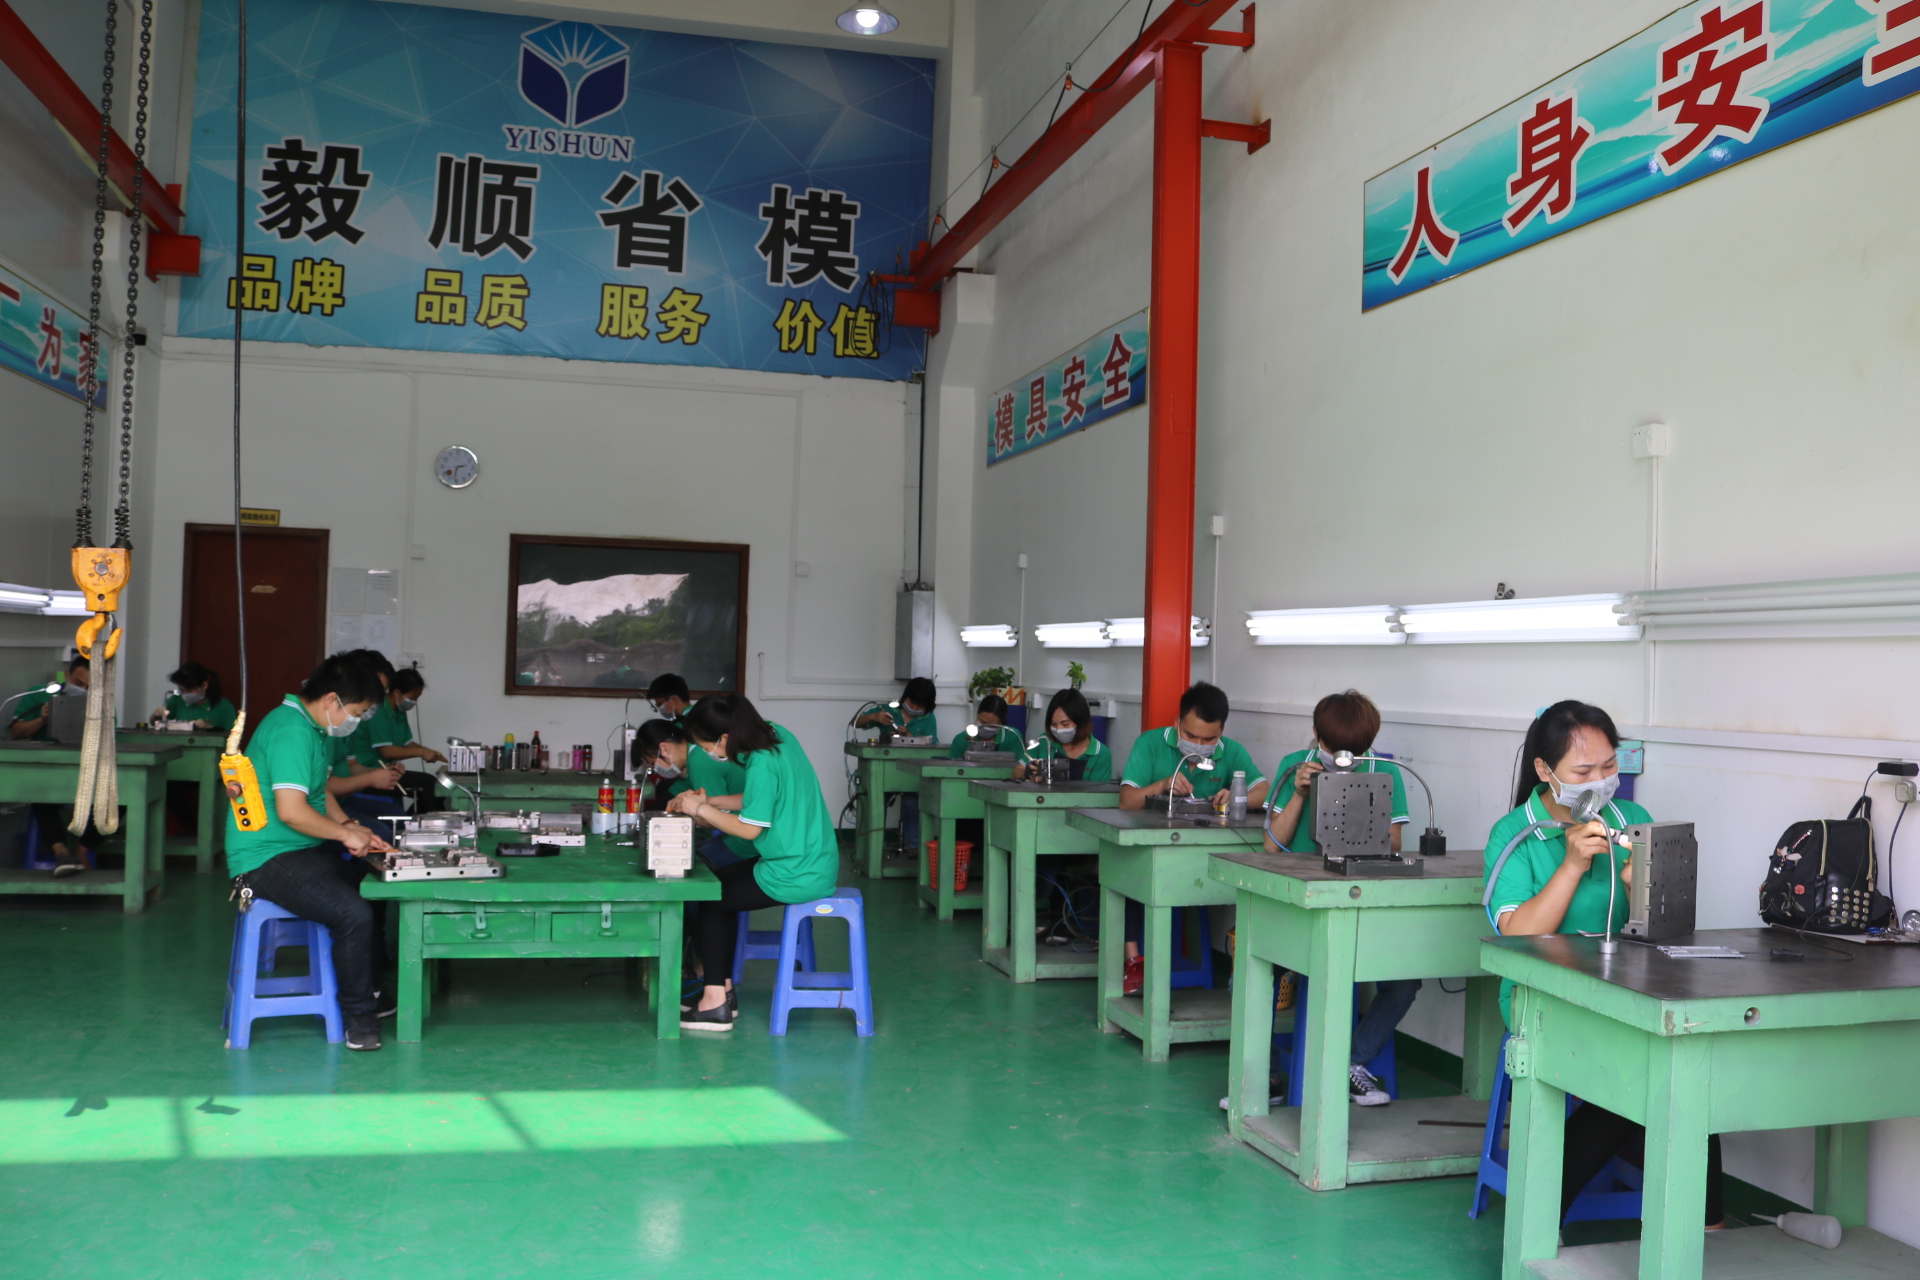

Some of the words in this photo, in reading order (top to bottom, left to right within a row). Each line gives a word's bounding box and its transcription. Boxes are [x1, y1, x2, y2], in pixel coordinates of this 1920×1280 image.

[504, 126, 633, 160] YISHUN
[257, 138, 860, 291] 毅顺省模
[227, 253, 345, 316] 品牌
[415, 268, 530, 331] 品质
[595, 283, 710, 345] 服务
[773, 298, 880, 359] 价值
[994, 333, 1132, 455] 模具安全
